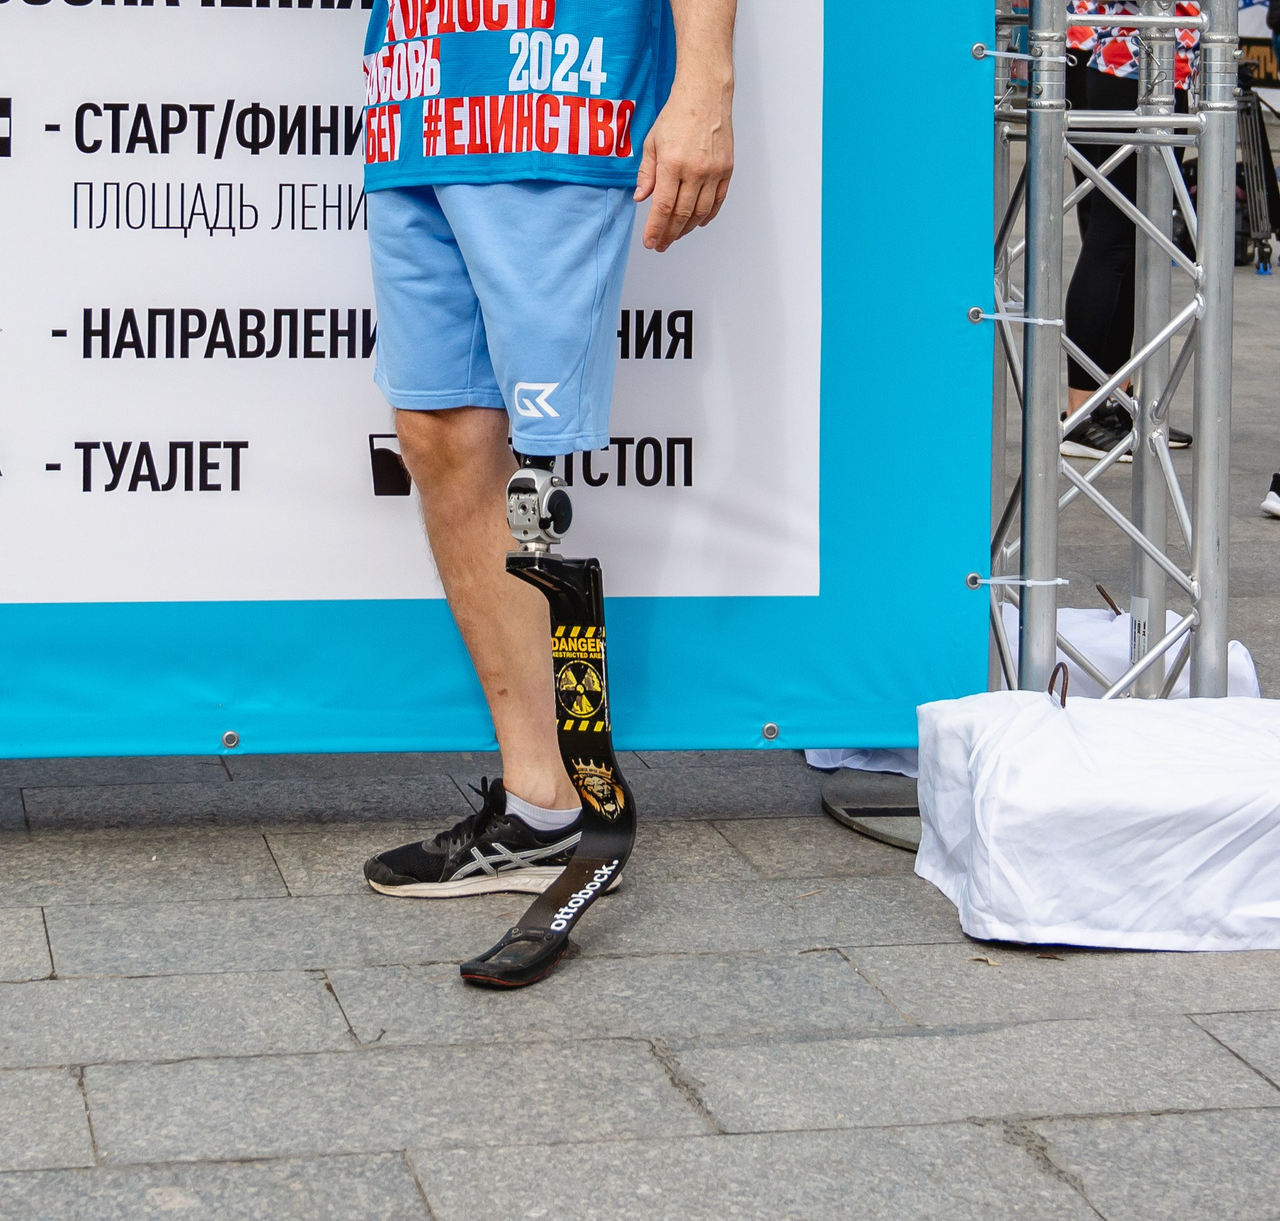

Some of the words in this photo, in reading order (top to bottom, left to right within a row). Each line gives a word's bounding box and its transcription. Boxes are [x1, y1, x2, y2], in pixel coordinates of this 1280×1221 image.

[509, 31, 607, 96] 2024
[75, 100, 363, 159] СТАРТ/ФИНИ
[423, 93, 636, 158] #ЕДИНСТВО
[73, 182, 258, 238] ПЛОЩАДЬ
[271, 183, 368, 231] ЛЕНИ
[83, 307, 378, 360] НАПРАВЛЕНИ
[75, 441, 248, 492] ТУАЛЕТ
